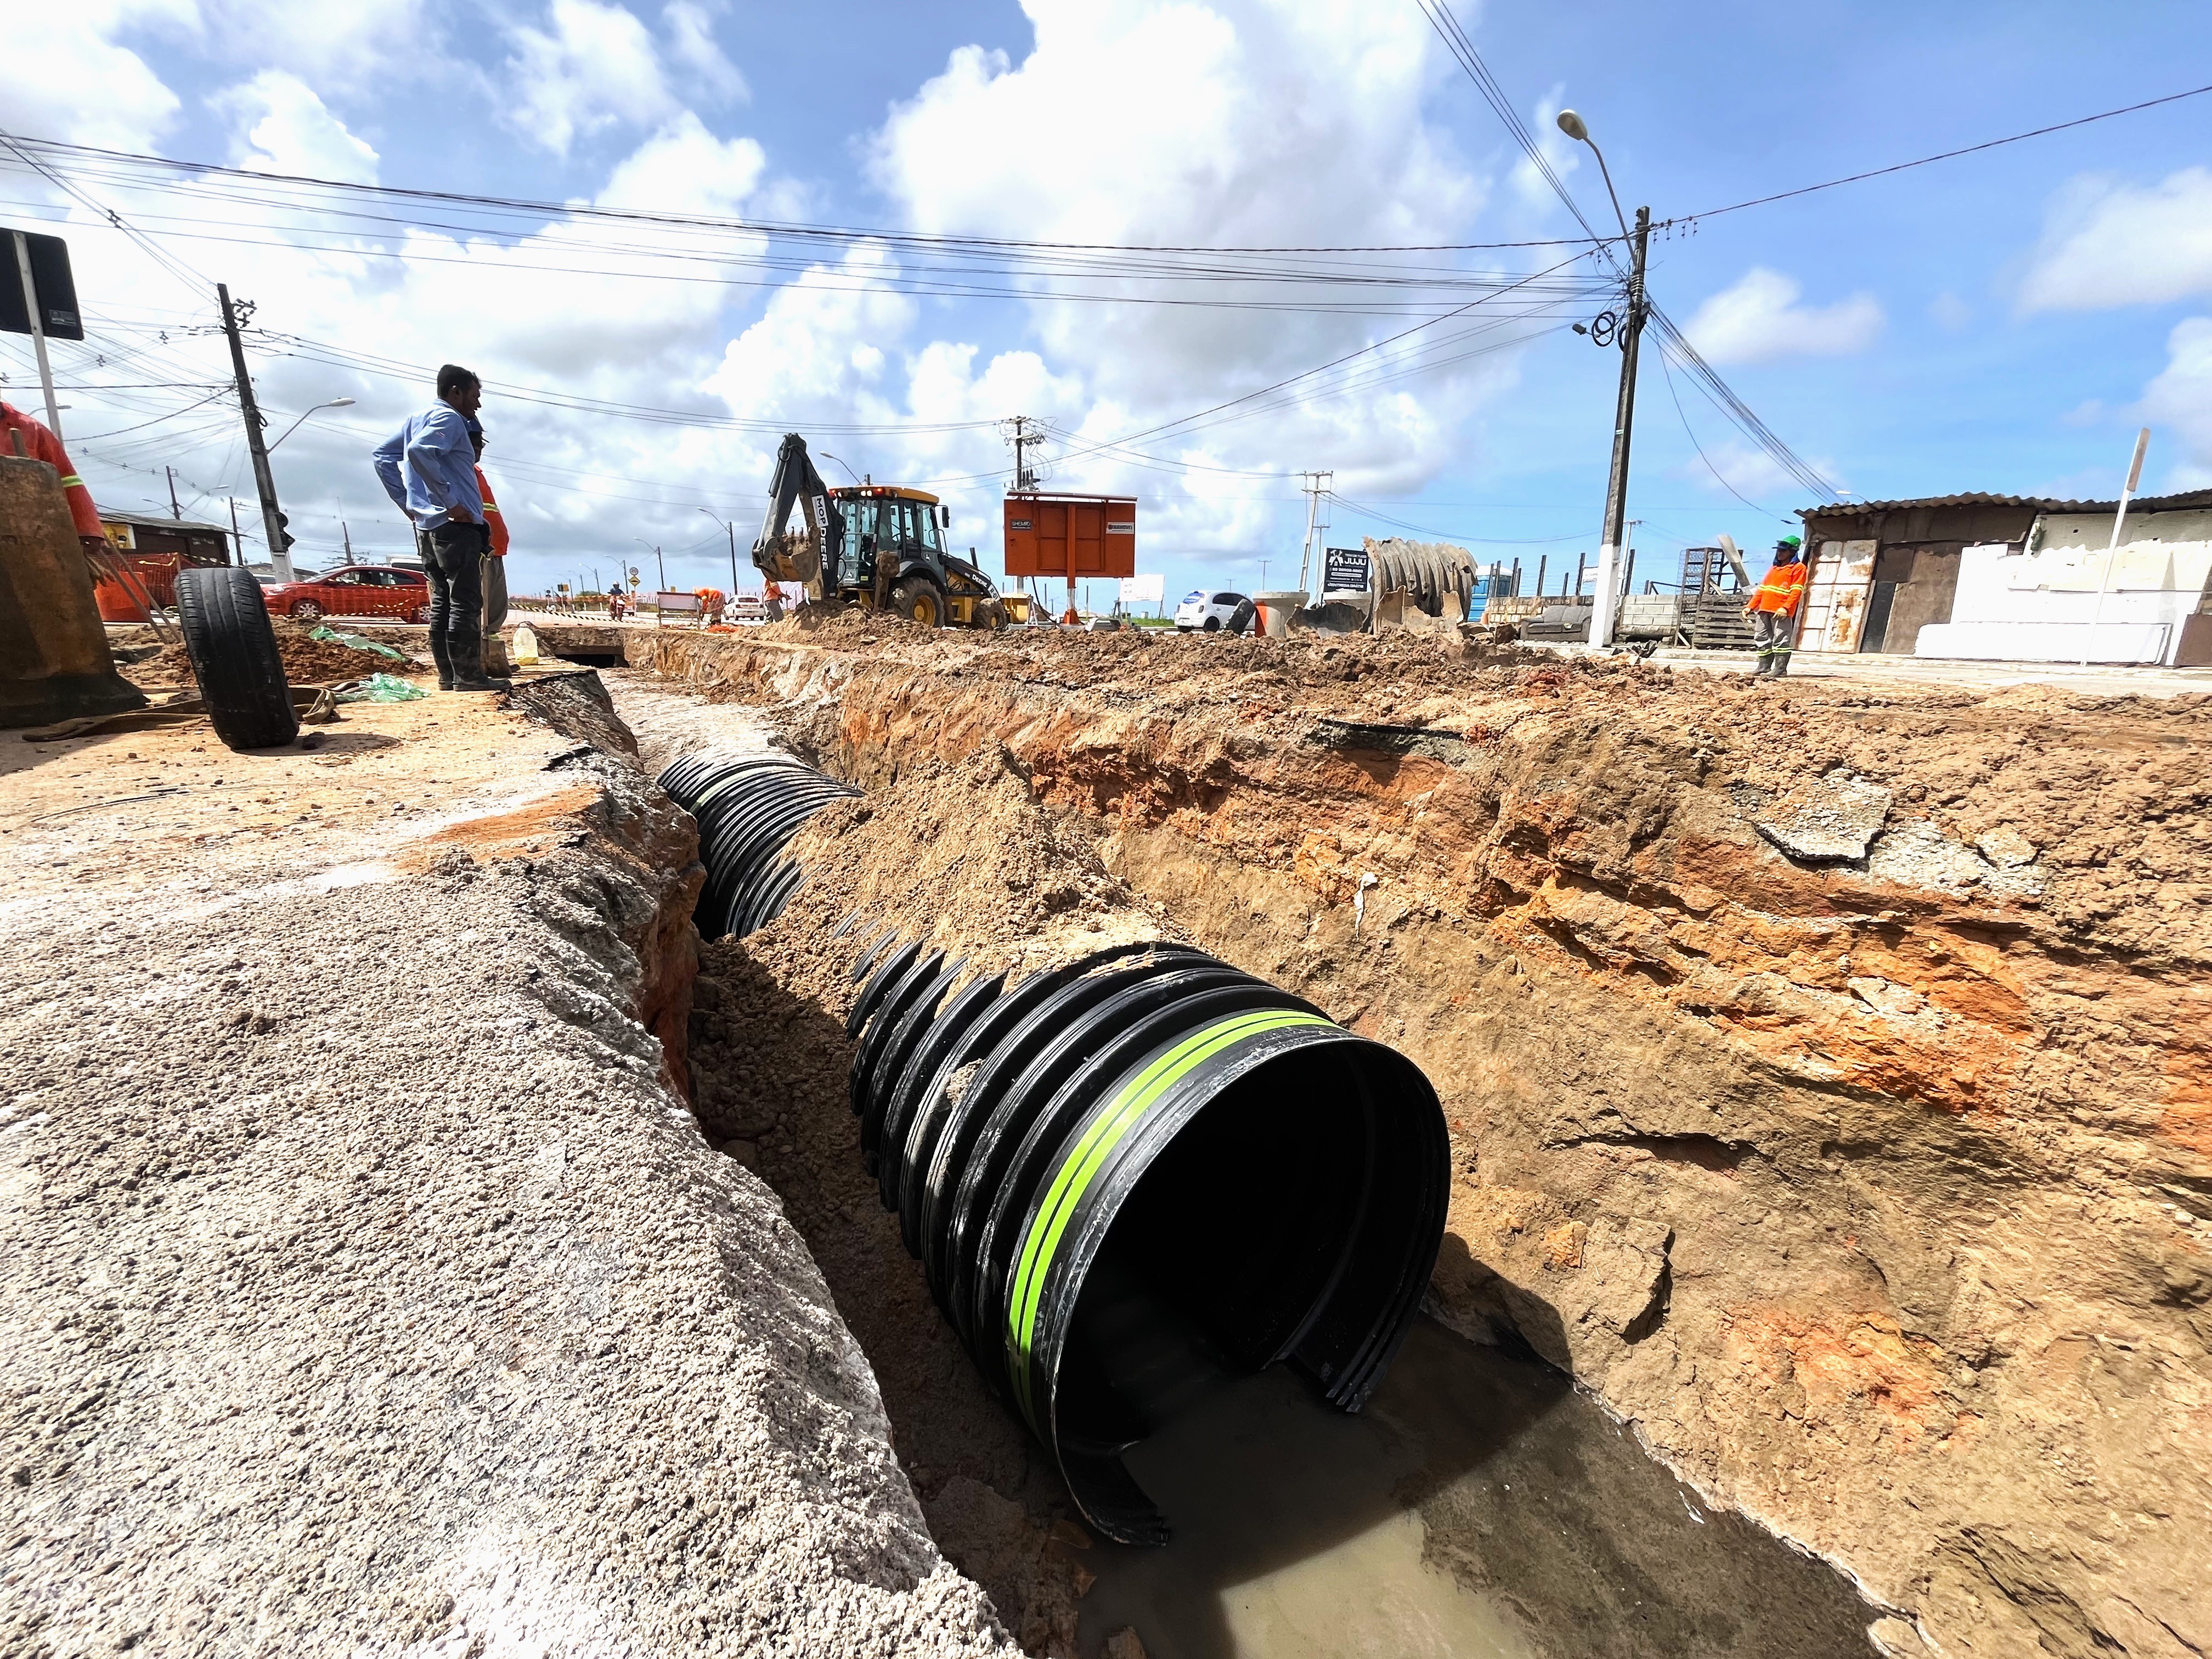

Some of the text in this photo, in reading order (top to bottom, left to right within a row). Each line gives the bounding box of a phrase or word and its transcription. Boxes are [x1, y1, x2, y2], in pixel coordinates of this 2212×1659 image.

[816, 498, 826, 525] MOP
[820, 527, 828, 570] DEERE
[1344, 557, 1367, 566] JUJU
[972, 573, 988, 588] DEERE
